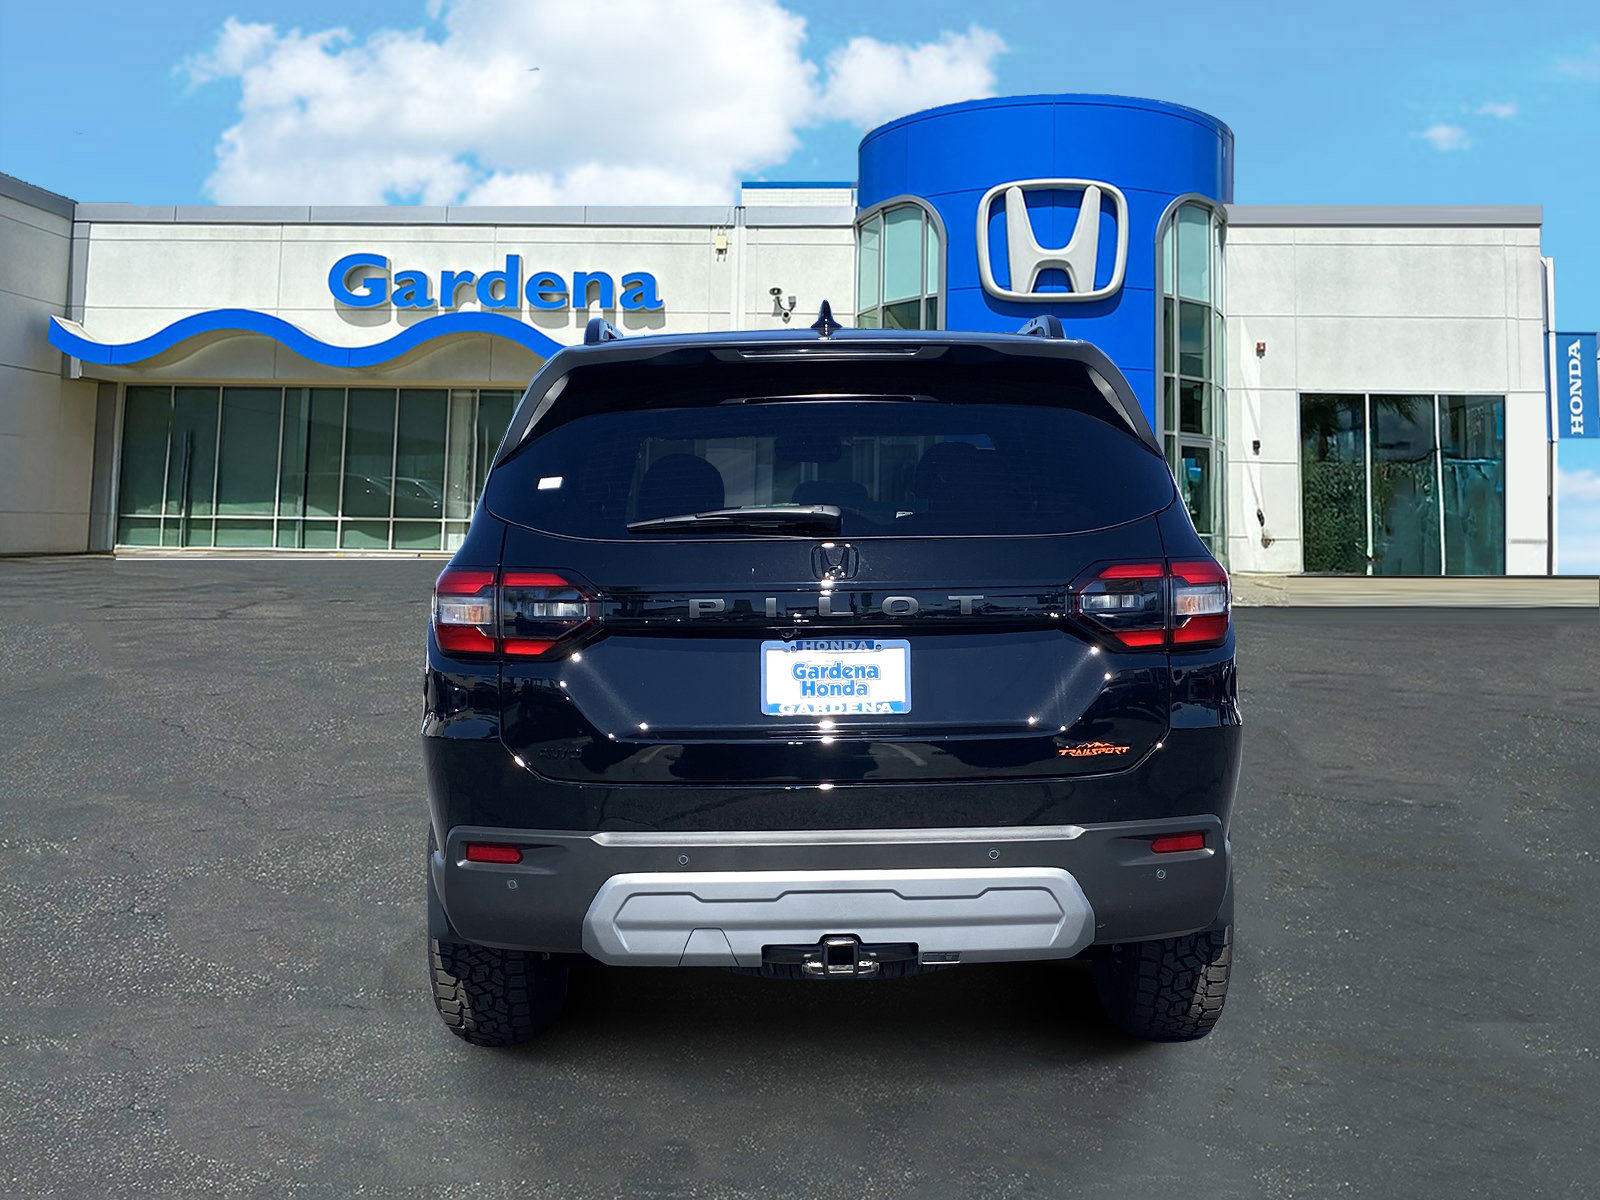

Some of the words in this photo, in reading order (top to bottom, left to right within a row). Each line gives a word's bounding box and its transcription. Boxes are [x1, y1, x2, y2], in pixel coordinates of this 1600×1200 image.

[328, 253, 664, 311] Gardena
[1567, 338, 1584, 435] HONDA
[688, 595, 984, 618] PILOT
[802, 640, 869, 651] HONDA
[792, 662, 880, 680] Gardena
[801, 680, 869, 696] Honda
[778, 702, 894, 714] GARDENA
[1058, 745, 1130, 757] TRAILSPORT
